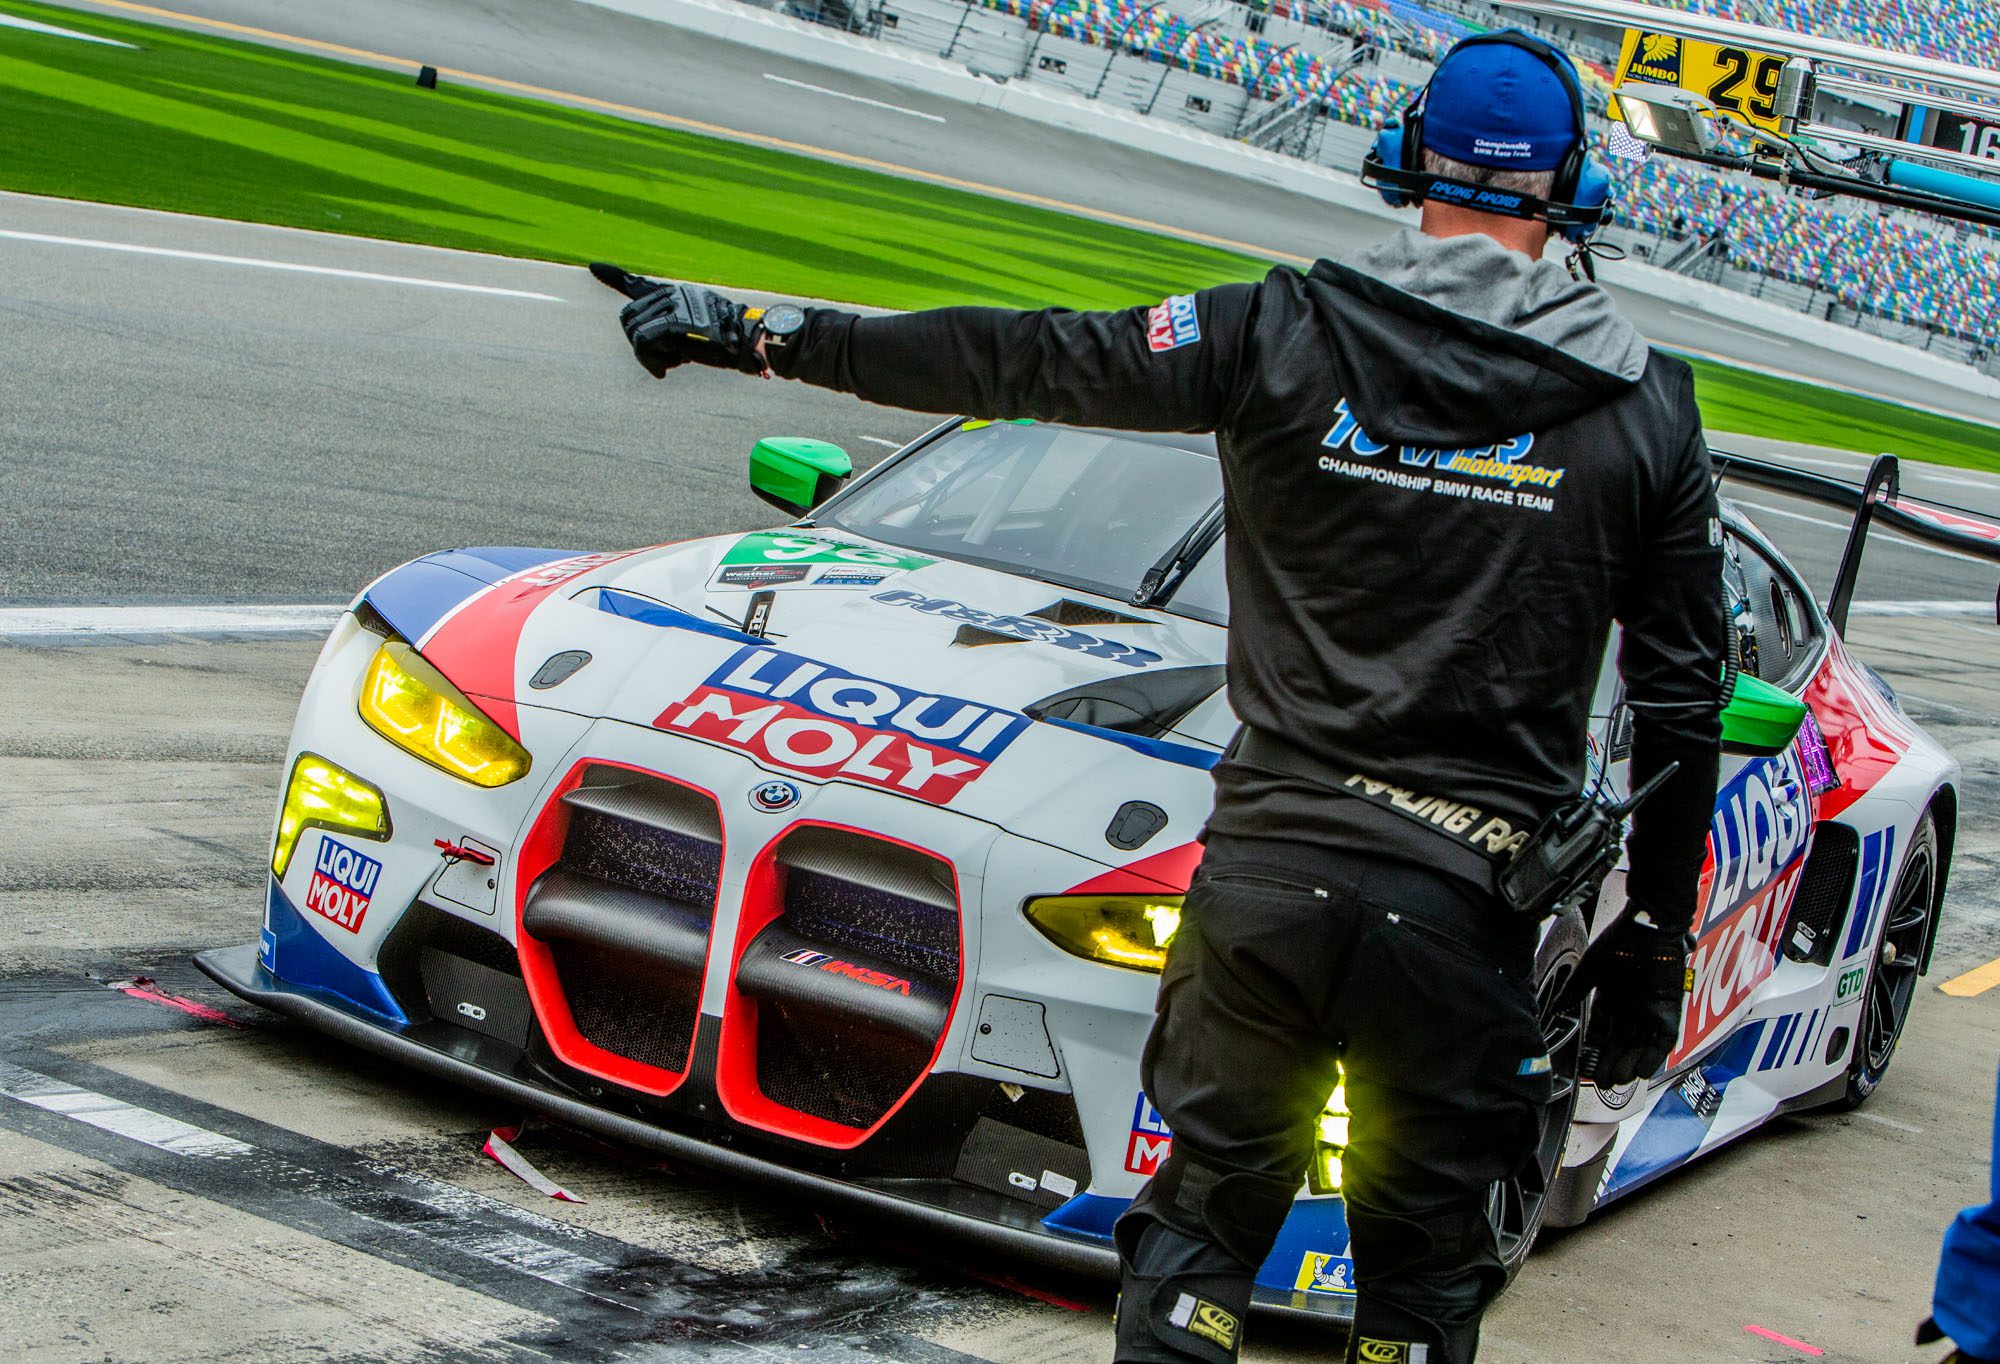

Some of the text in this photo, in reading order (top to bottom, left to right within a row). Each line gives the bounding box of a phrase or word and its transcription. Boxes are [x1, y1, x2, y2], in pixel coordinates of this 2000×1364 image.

[1629, 62, 1678, 83] JUMBO
[1706, 46, 1787, 121] 29
[1475, 138, 1531, 151] Championship
[1429, 180, 1475, 200] RACING
[1476, 190, 1522, 209] RADIOS
[1151, 304, 1175, 346] OLY
[1318, 455, 1554, 512] CHAMPIONSHIP BMW RACE TEAM
[1450, 455, 1566, 488] motorsport
[763, 537, 906, 564] 96
[722, 650, 1017, 753] LIQUI
[670, 693, 981, 791] MOLY
[1708, 747, 1806, 923] LIQUI
[318, 840, 379, 895] LIQUI
[308, 875, 369, 929] MOLY
[820, 960, 911, 996] IMSA
[1675, 867, 1801, 1055] MOLY
[1837, 967, 1864, 999] GTD
[1697, 1086, 1717, 1121] RACING
